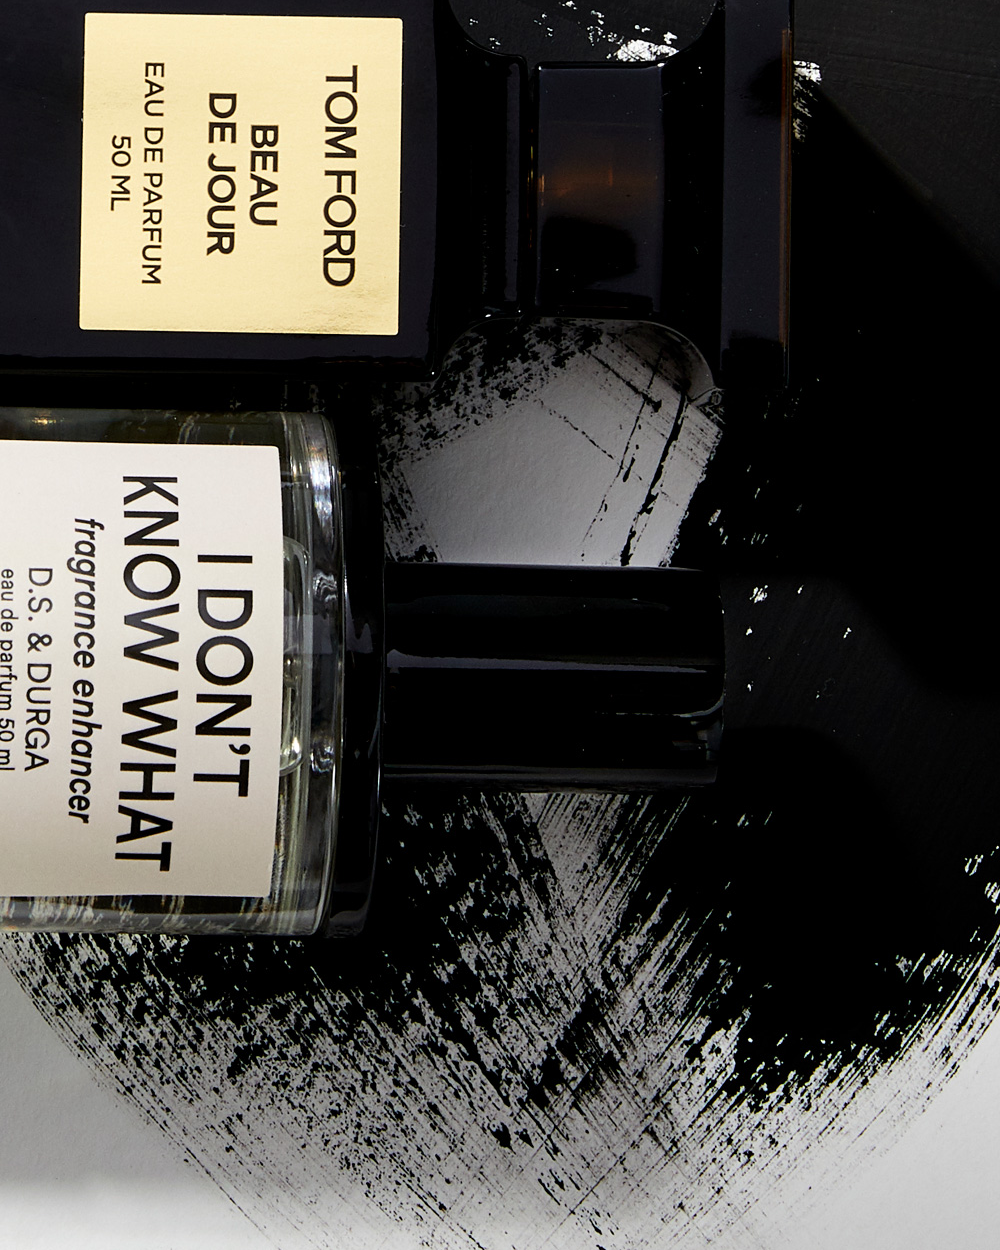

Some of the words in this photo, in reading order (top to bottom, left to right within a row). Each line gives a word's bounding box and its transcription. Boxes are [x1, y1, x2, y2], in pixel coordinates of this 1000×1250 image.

[144, 62, 165, 117] EAU
[208, 92, 238, 144] DE
[324, 64, 358, 159] TOM
[111, 135, 132, 168] 50
[143, 126, 164, 163] DE
[249, 124, 279, 226] BEAU
[110, 175, 131, 212] ML
[141, 172, 163, 284] PARFUM
[206, 152, 237, 256] JOUR
[322, 169, 357, 287] FORD
[0, 568, 14, 601] eau
[27, 567, 53, 622] D.S.
[66, 518, 105, 669] fragrance
[122, 475, 181, 672] KNOW
[197, 554, 253, 564] I
[0, 608, 19, 633] de
[27, 632, 53, 653] &
[24, 663, 52, 772] DURGA
[67, 679, 103, 825] enhancer
[114, 689, 179, 873] WHAT
